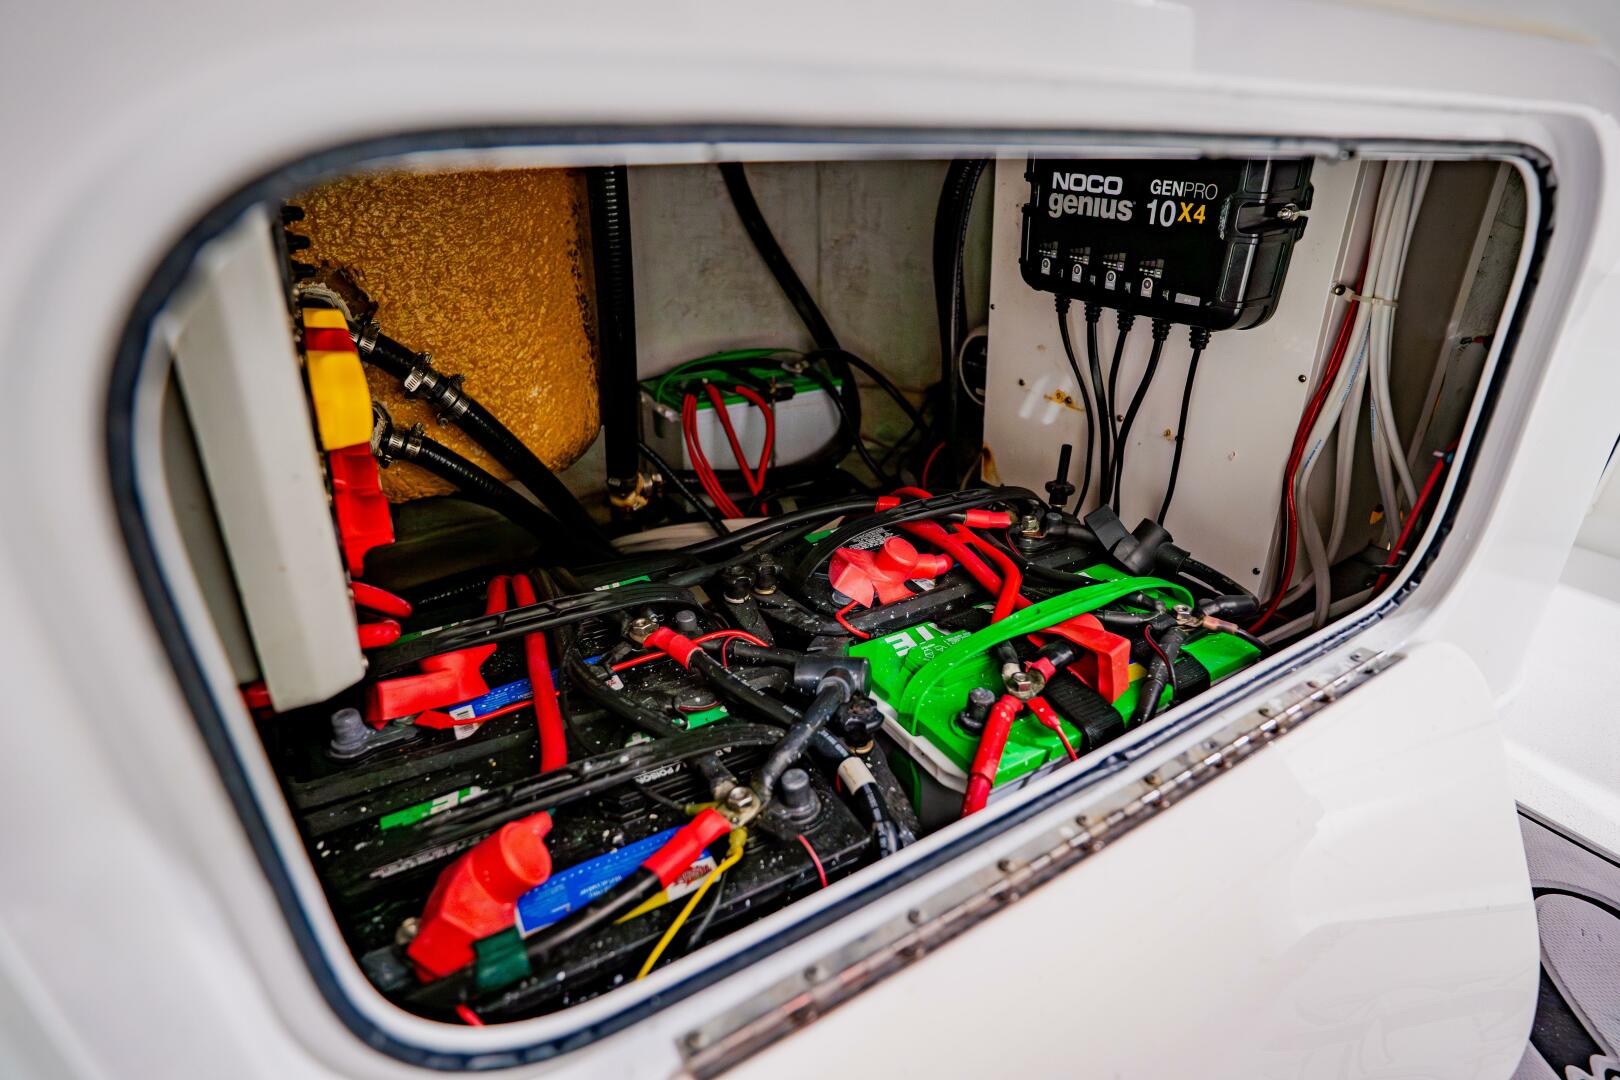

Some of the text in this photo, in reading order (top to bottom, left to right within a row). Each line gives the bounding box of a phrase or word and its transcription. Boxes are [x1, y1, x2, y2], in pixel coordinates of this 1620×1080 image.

[1052, 171, 1123, 195] NOCO
[1150, 179, 1218, 200] GENPRO
[1048, 192, 1133, 221] genius
